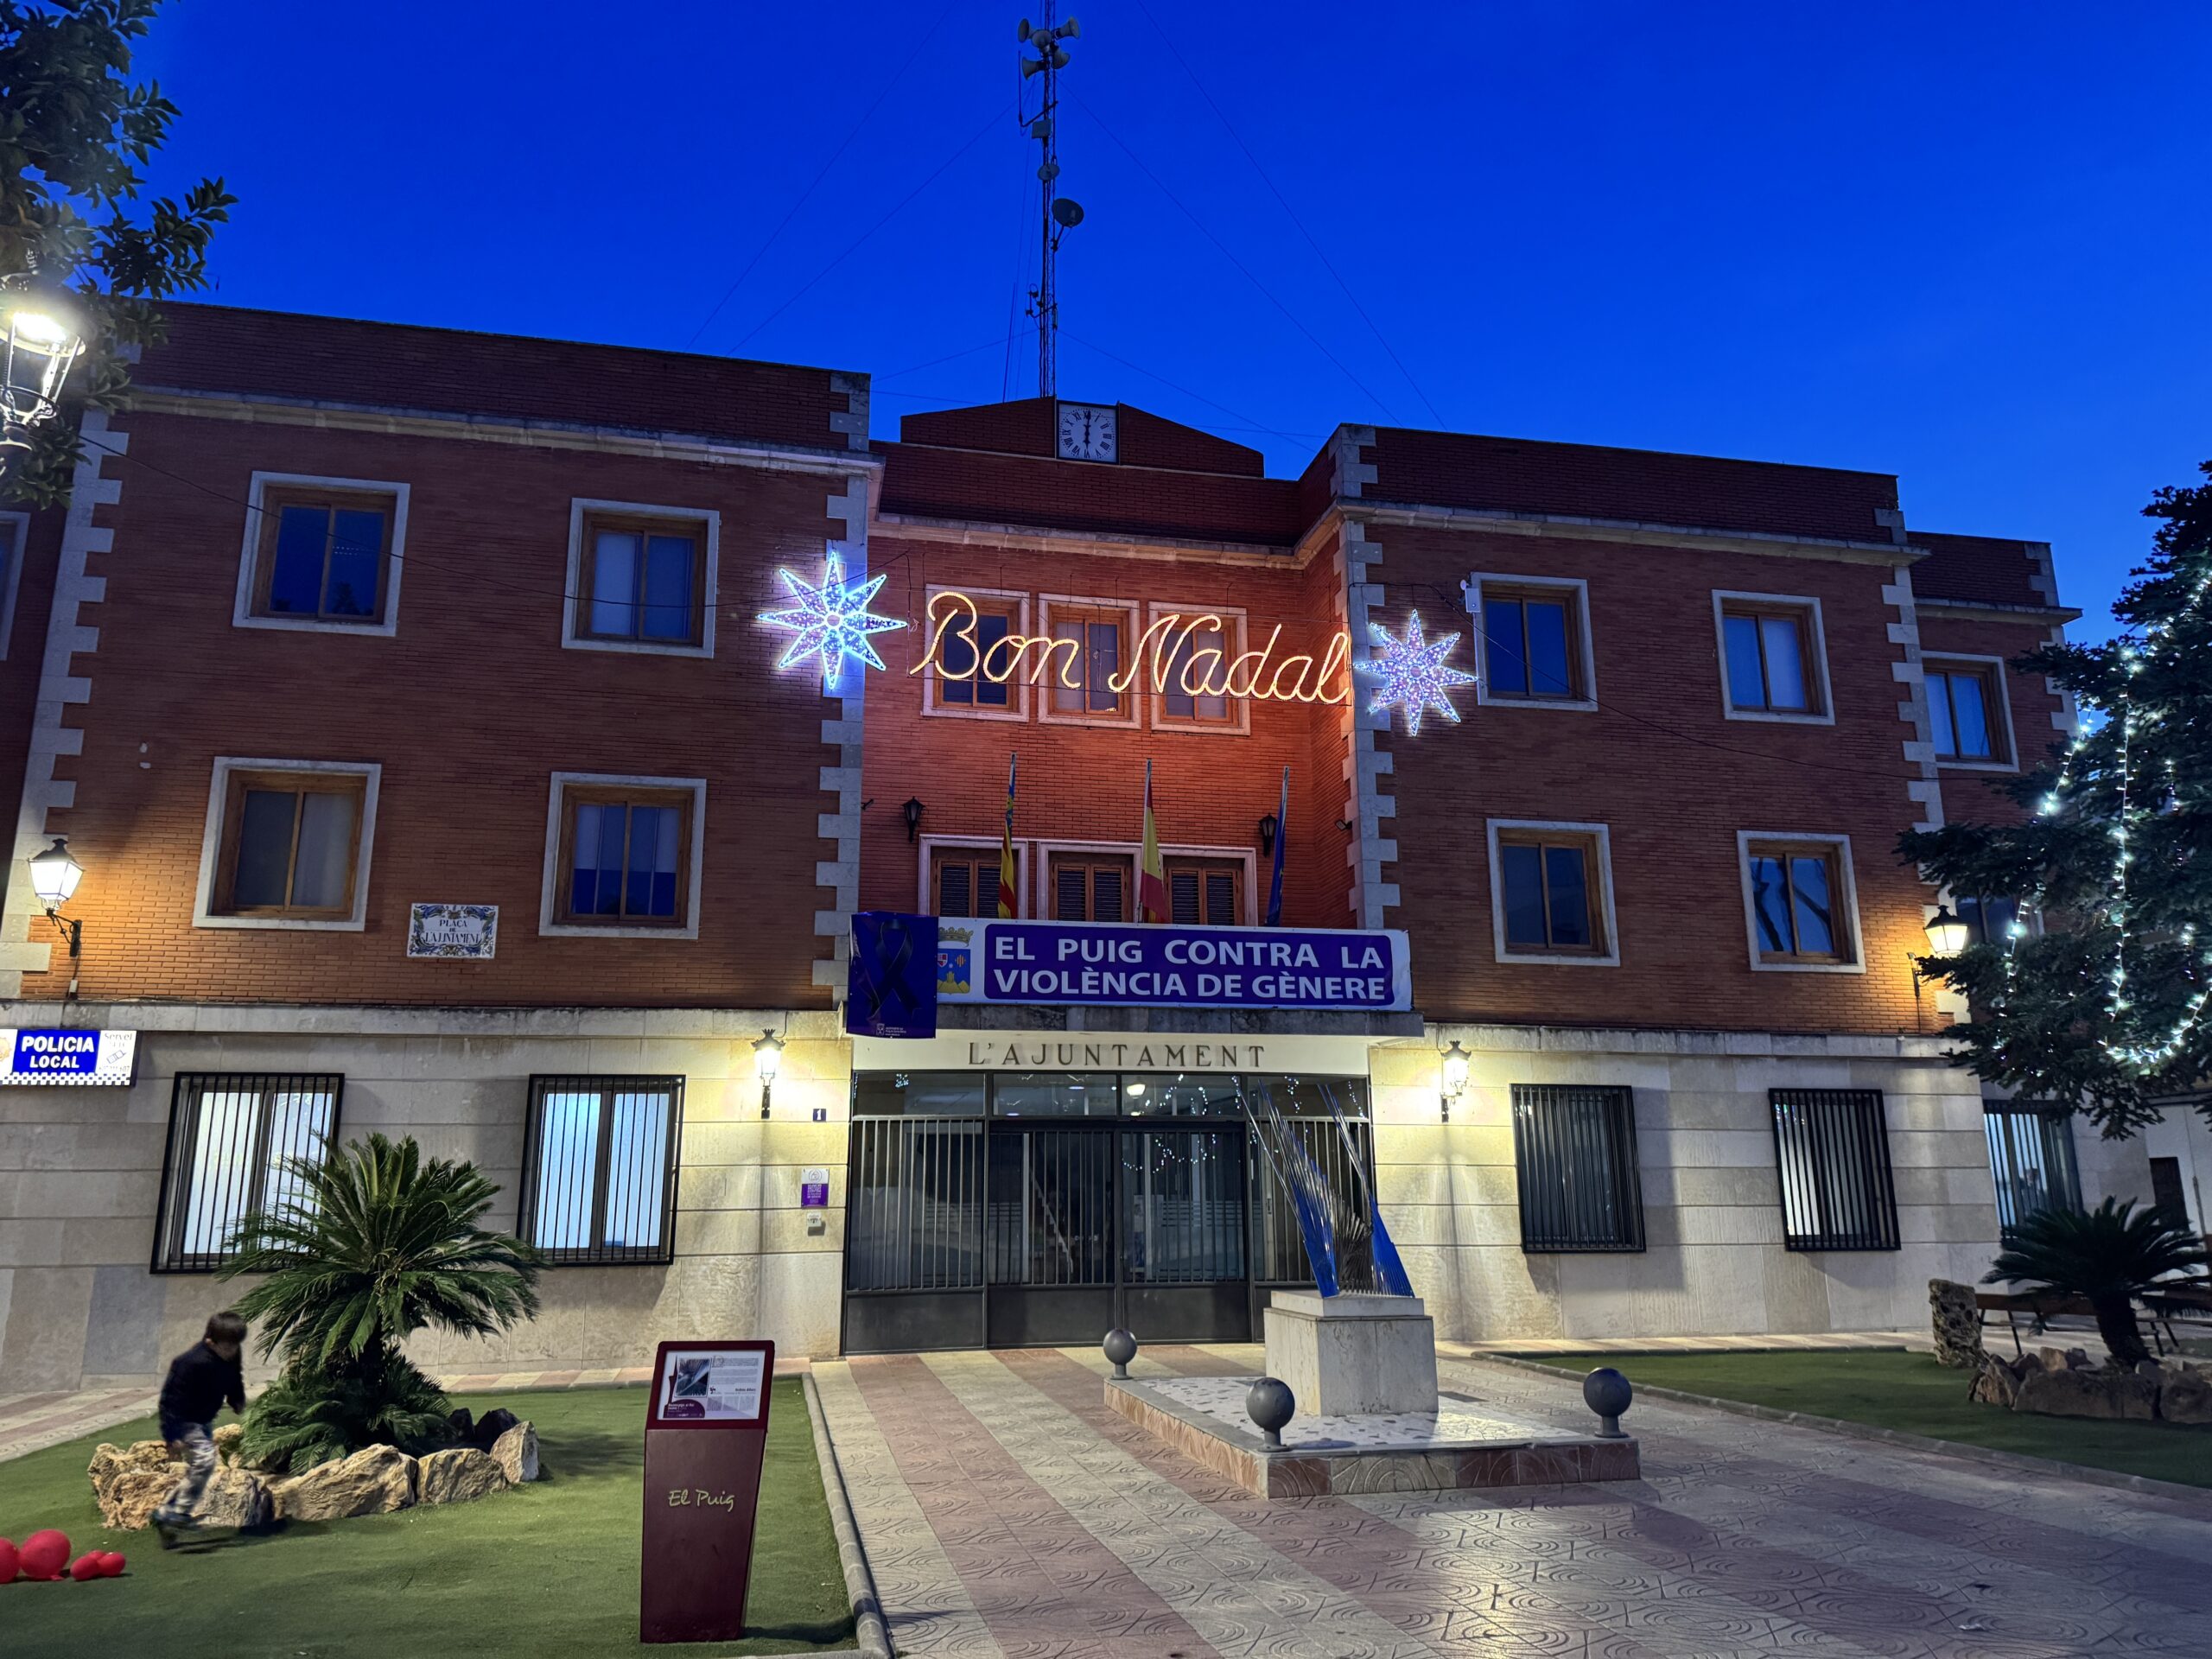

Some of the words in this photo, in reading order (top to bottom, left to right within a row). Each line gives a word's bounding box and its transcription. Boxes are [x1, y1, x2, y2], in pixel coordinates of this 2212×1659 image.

[910, 591, 1081, 689] Bon
[1108, 614, 1350, 704] Nadal
[440, 918, 467, 928] PLAÇA
[995, 937, 1035, 960] EL
[1058, 938, 1142, 963] PUIG
[1165, 939, 1319, 968] CONTRA
[1341, 946, 1384, 969] LA
[994, 966, 1187, 996] VIOLÈNCIA
[1197, 974, 1243, 997] DE
[1252, 970, 1385, 1000] GÈNERE
[22, 1036, 94, 1052] POLICIA
[969, 1041, 1264, 1067] L'AJUNTAMENT
[29, 1055, 79, 1068] LOCAL
[668, 1489, 691, 1507] El
[696, 1489, 735, 1512] Puig
